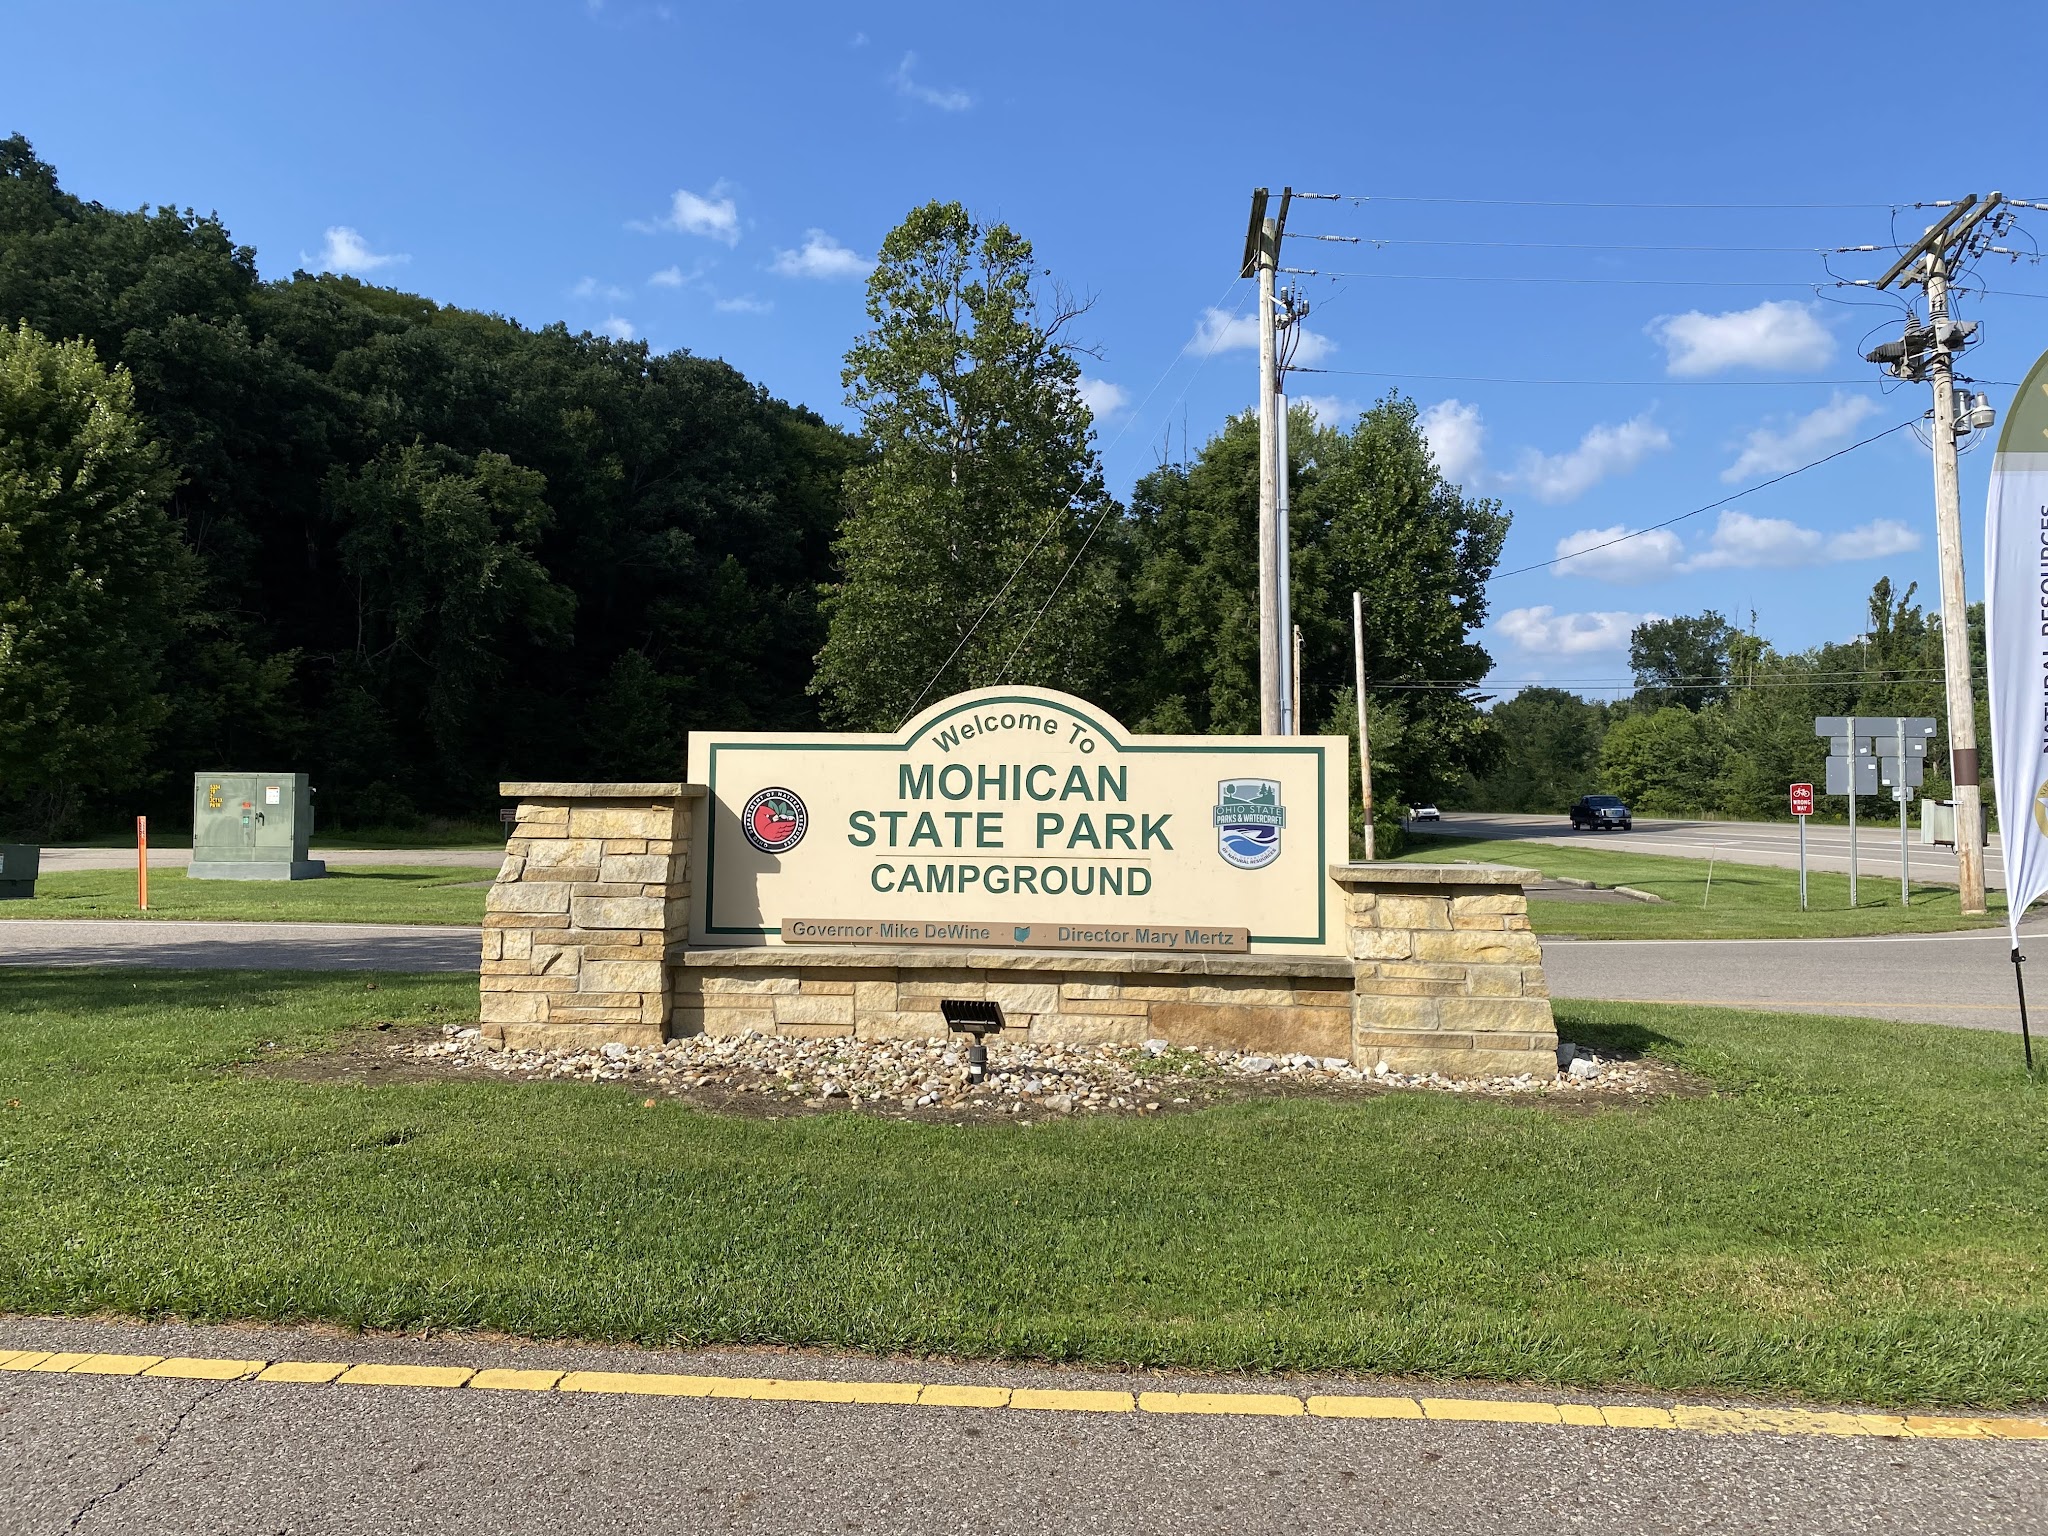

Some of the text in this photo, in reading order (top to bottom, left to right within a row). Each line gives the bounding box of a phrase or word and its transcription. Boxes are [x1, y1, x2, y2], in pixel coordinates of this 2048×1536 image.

[932, 713, 1095, 754] Welcome To
[899, 763, 1127, 802] MOHICAN
[747, 795, 764, 834] DEPARTMENT
[778, 792, 801, 812] NATURAL
[1217, 806, 1282, 815] OHIO STATE
[784, 814, 803, 847] RESOURCES
[847, 810, 1174, 851] STATE PARK
[1217, 814, 1282, 825] PARKS & WATERCRAFT
[1228, 853, 1249, 864] NATURAL
[1250, 848, 1277, 864] RESOURCES
[871, 863, 1152, 896] CAMPGROUND
[792, 921, 990, 939] Governor Mike DeWine
[1058, 926, 1234, 947] Director Mary Mertz
